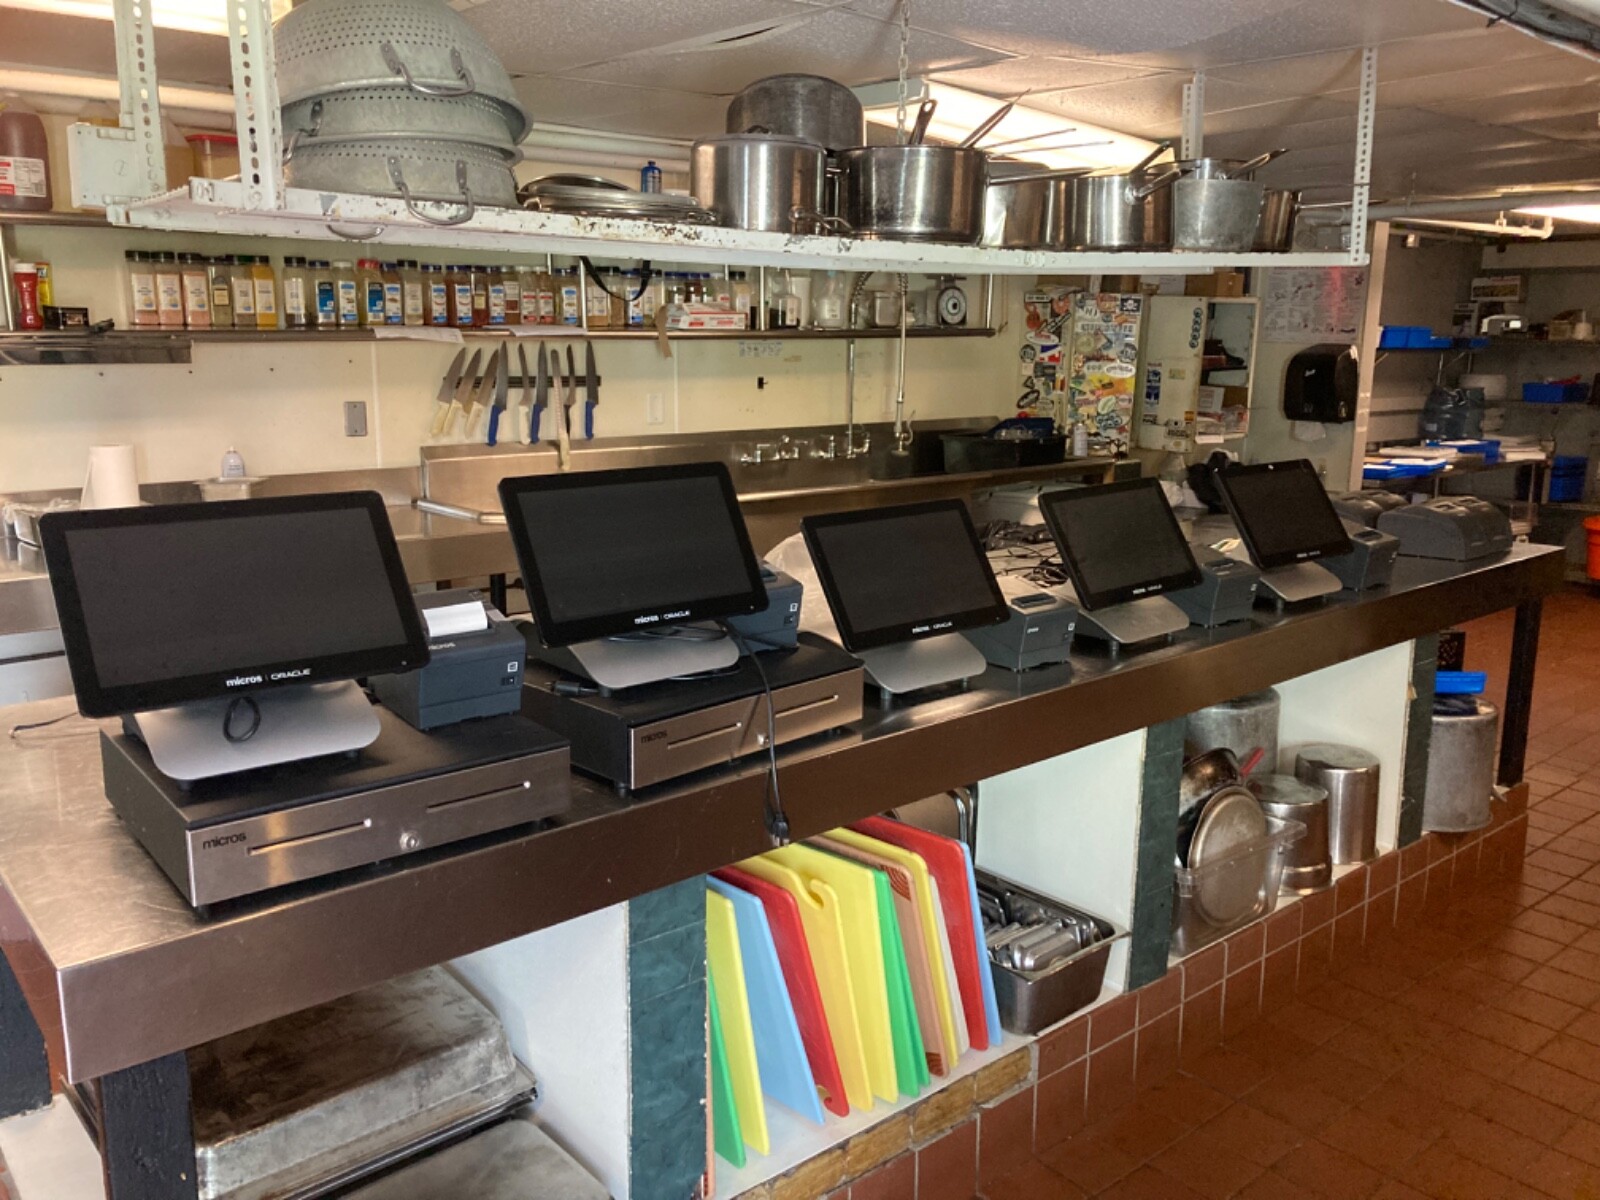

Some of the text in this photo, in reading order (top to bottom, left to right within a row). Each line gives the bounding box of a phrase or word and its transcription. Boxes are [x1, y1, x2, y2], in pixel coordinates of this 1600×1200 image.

[225, 668, 311, 687] micros ORACLE
[202, 832, 247, 850] micros
